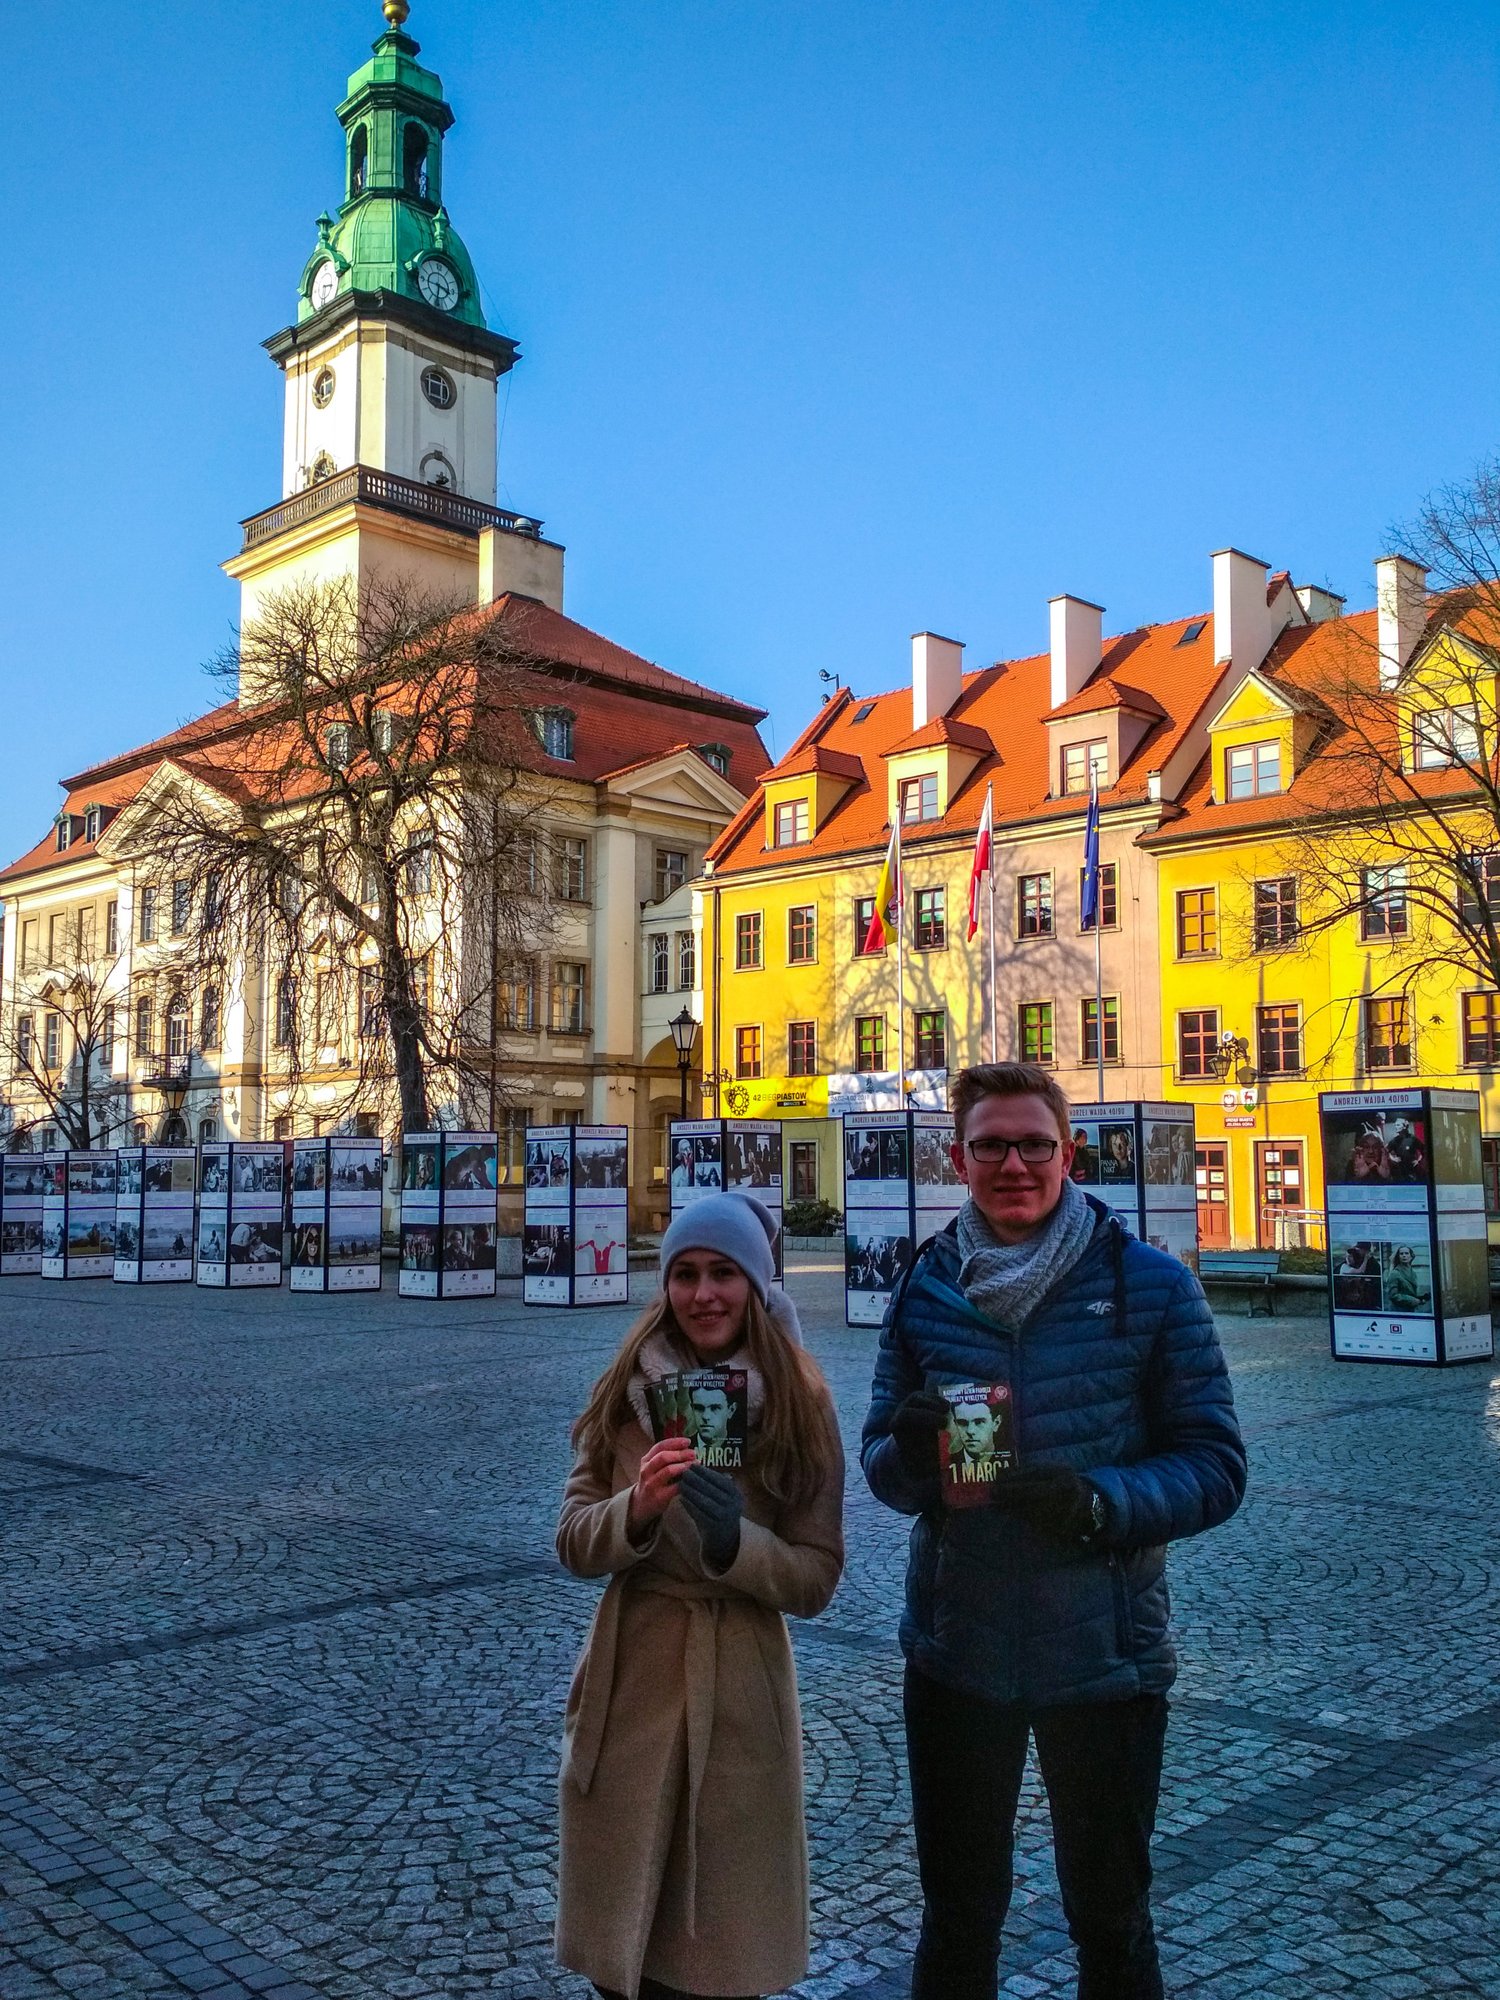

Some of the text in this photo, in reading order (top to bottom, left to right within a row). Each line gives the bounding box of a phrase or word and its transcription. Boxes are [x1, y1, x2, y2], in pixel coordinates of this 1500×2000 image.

[1333, 1096, 1361, 1106] ANDRZEJ
[1363, 1095, 1386, 1104] WAJDA
[694, 1446, 742, 1467] MARCA
[949, 1463, 958, 1484] 1
